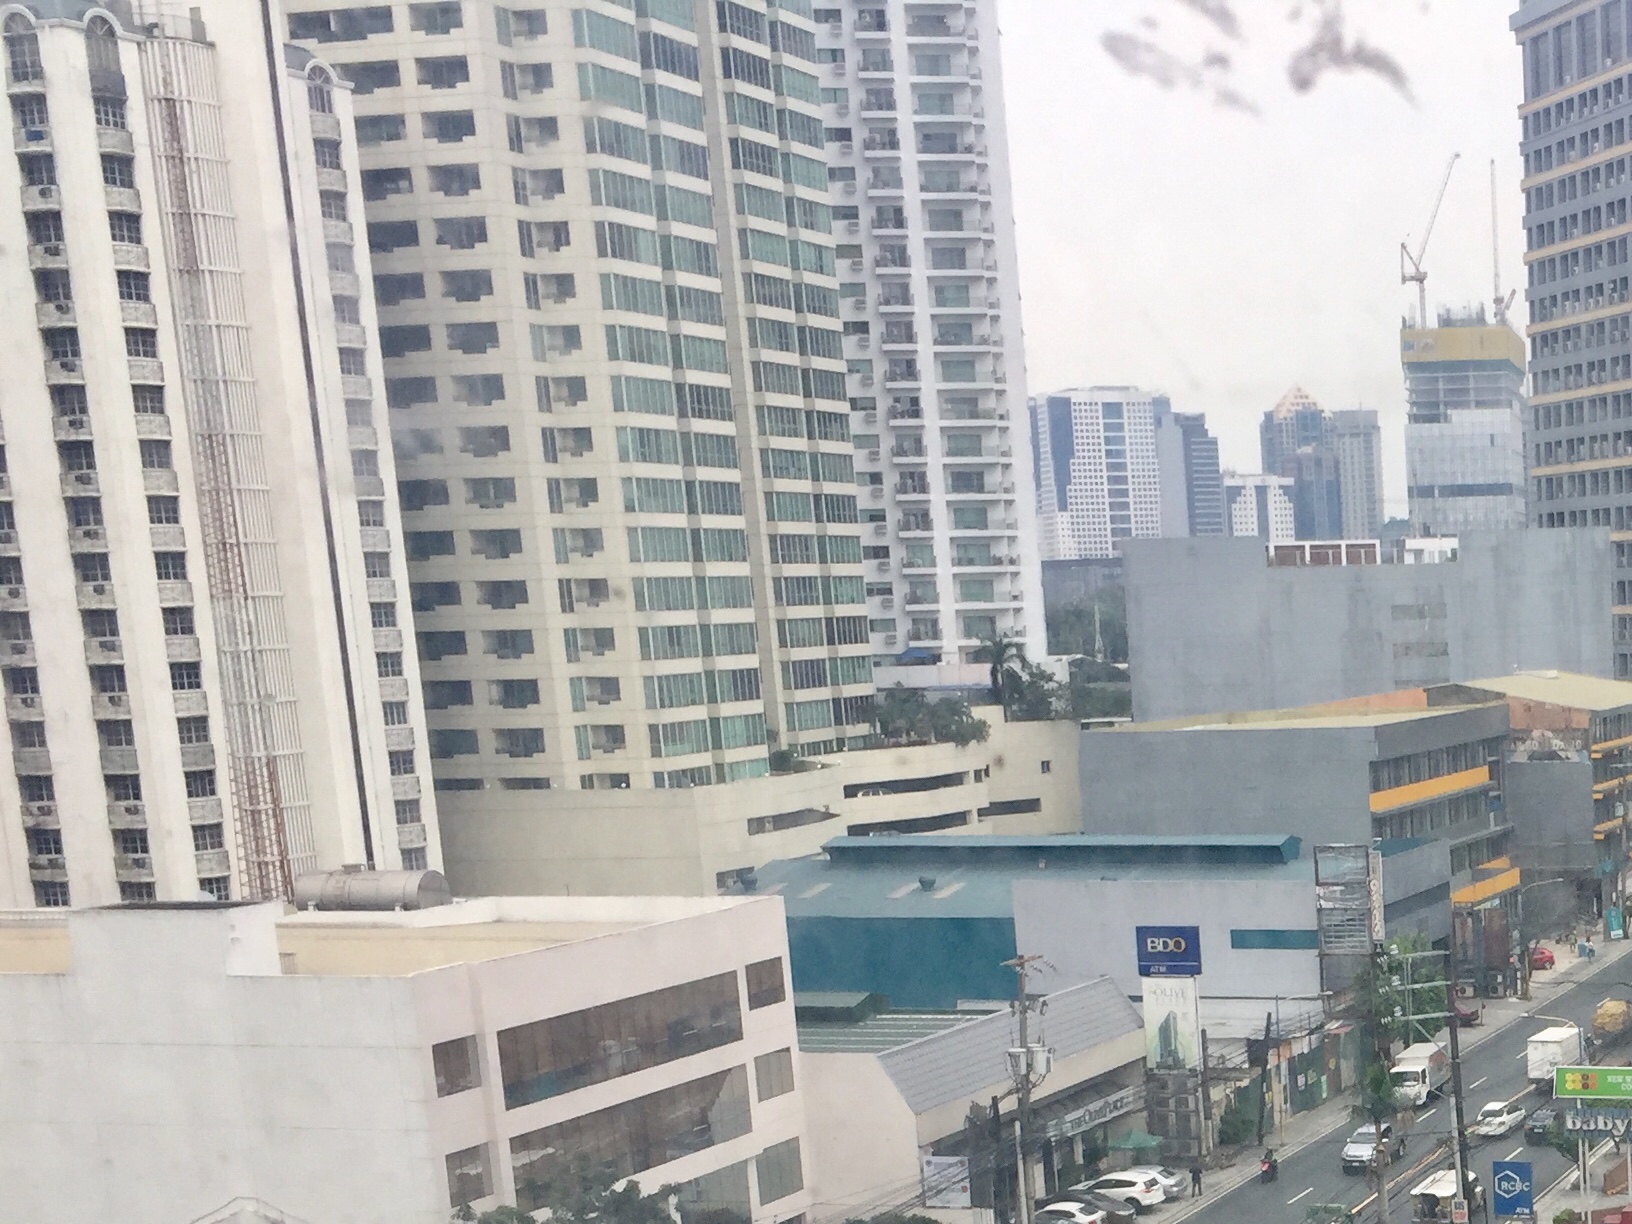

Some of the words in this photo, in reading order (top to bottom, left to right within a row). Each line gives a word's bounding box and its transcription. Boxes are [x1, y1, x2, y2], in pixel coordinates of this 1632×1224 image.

[1146, 936, 1186, 952] BDO
[1149, 965, 1167, 973] ATM
[1606, 1075, 1624, 1083] NEW
[1501, 1182, 1531, 1191] RCBC
